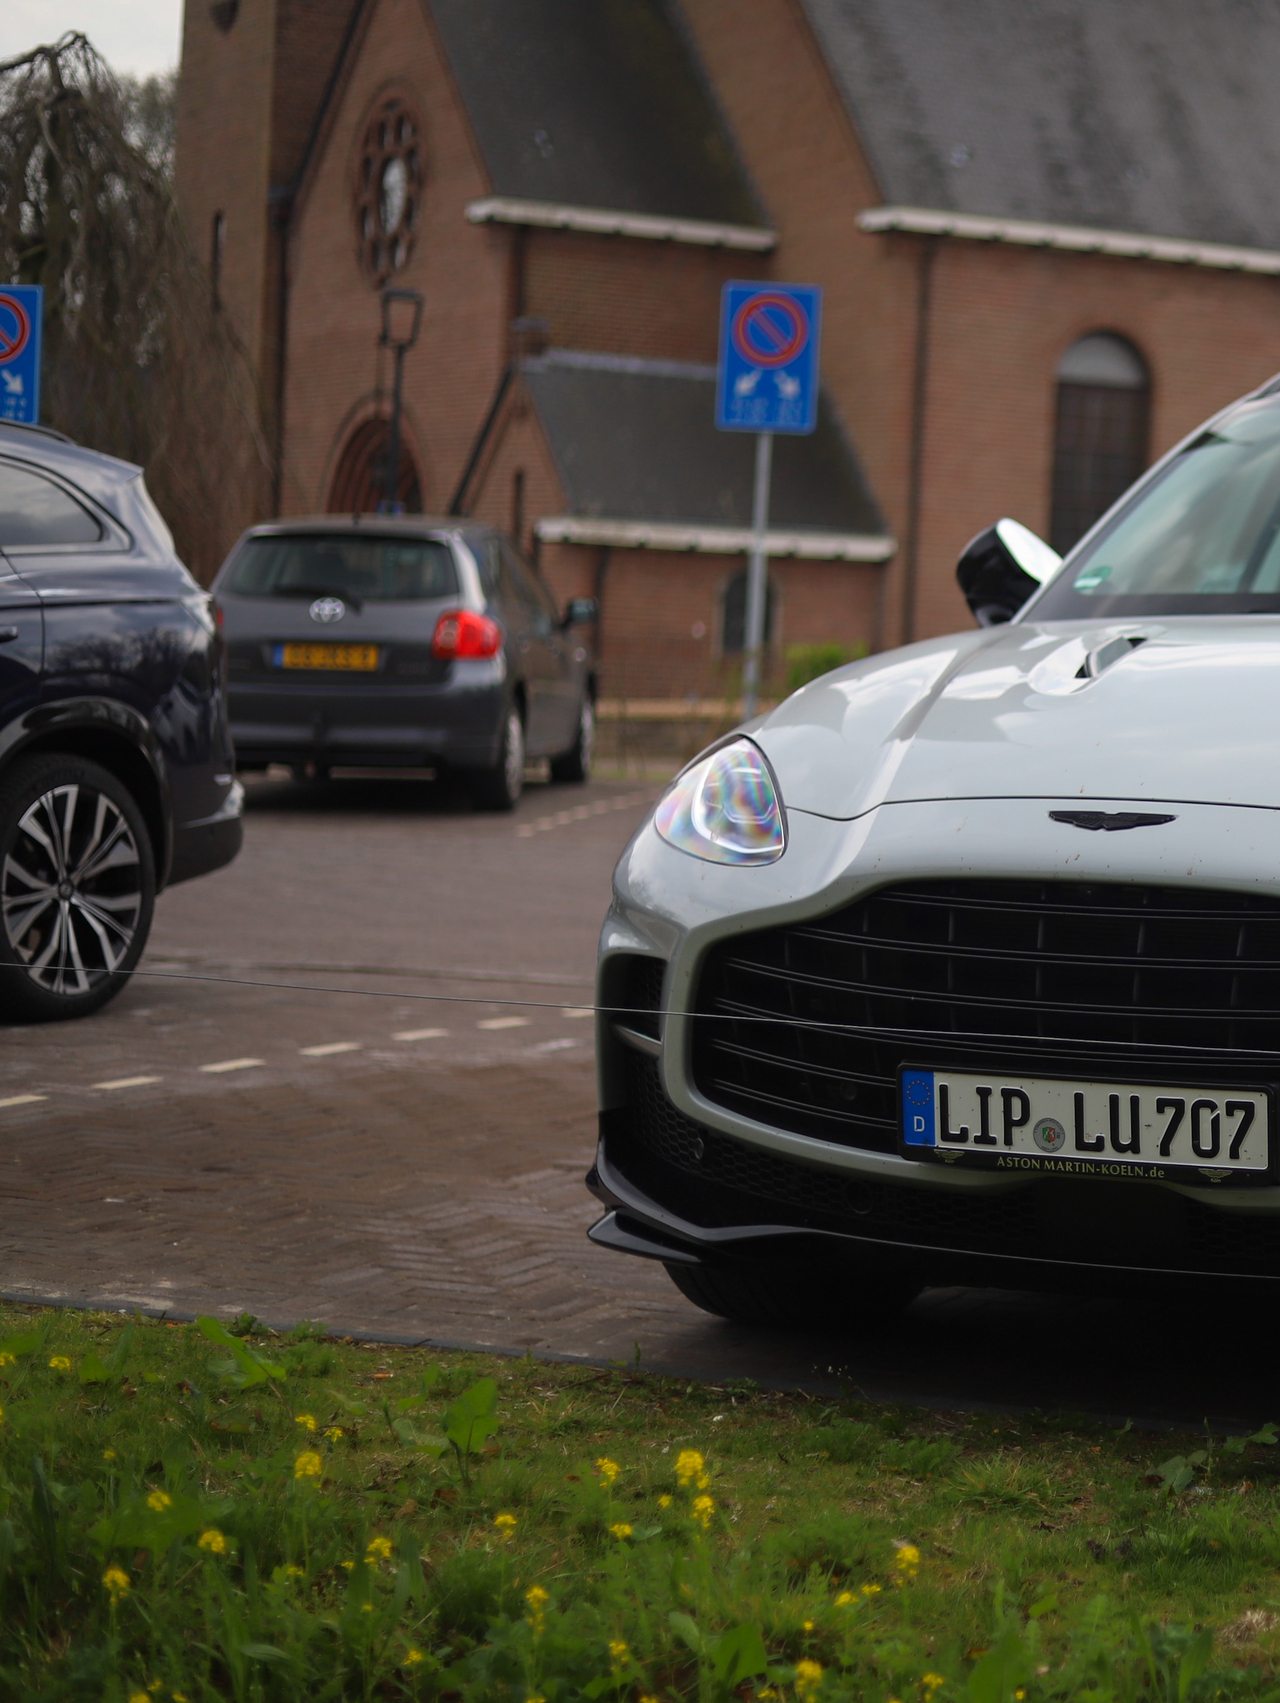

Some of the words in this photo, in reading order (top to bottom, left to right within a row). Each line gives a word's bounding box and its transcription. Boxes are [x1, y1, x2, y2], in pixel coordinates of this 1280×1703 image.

[913, 1116, 925, 1132] D
[938, 1083, 1031, 1147] LIP
[1073, 1092, 1141, 1154] LU
[1155, 1096, 1256, 1160] 707
[997, 1156, 1040, 1169] ASTON
[1044, 1160, 1165, 1178] MARTIN-KOELN.de
